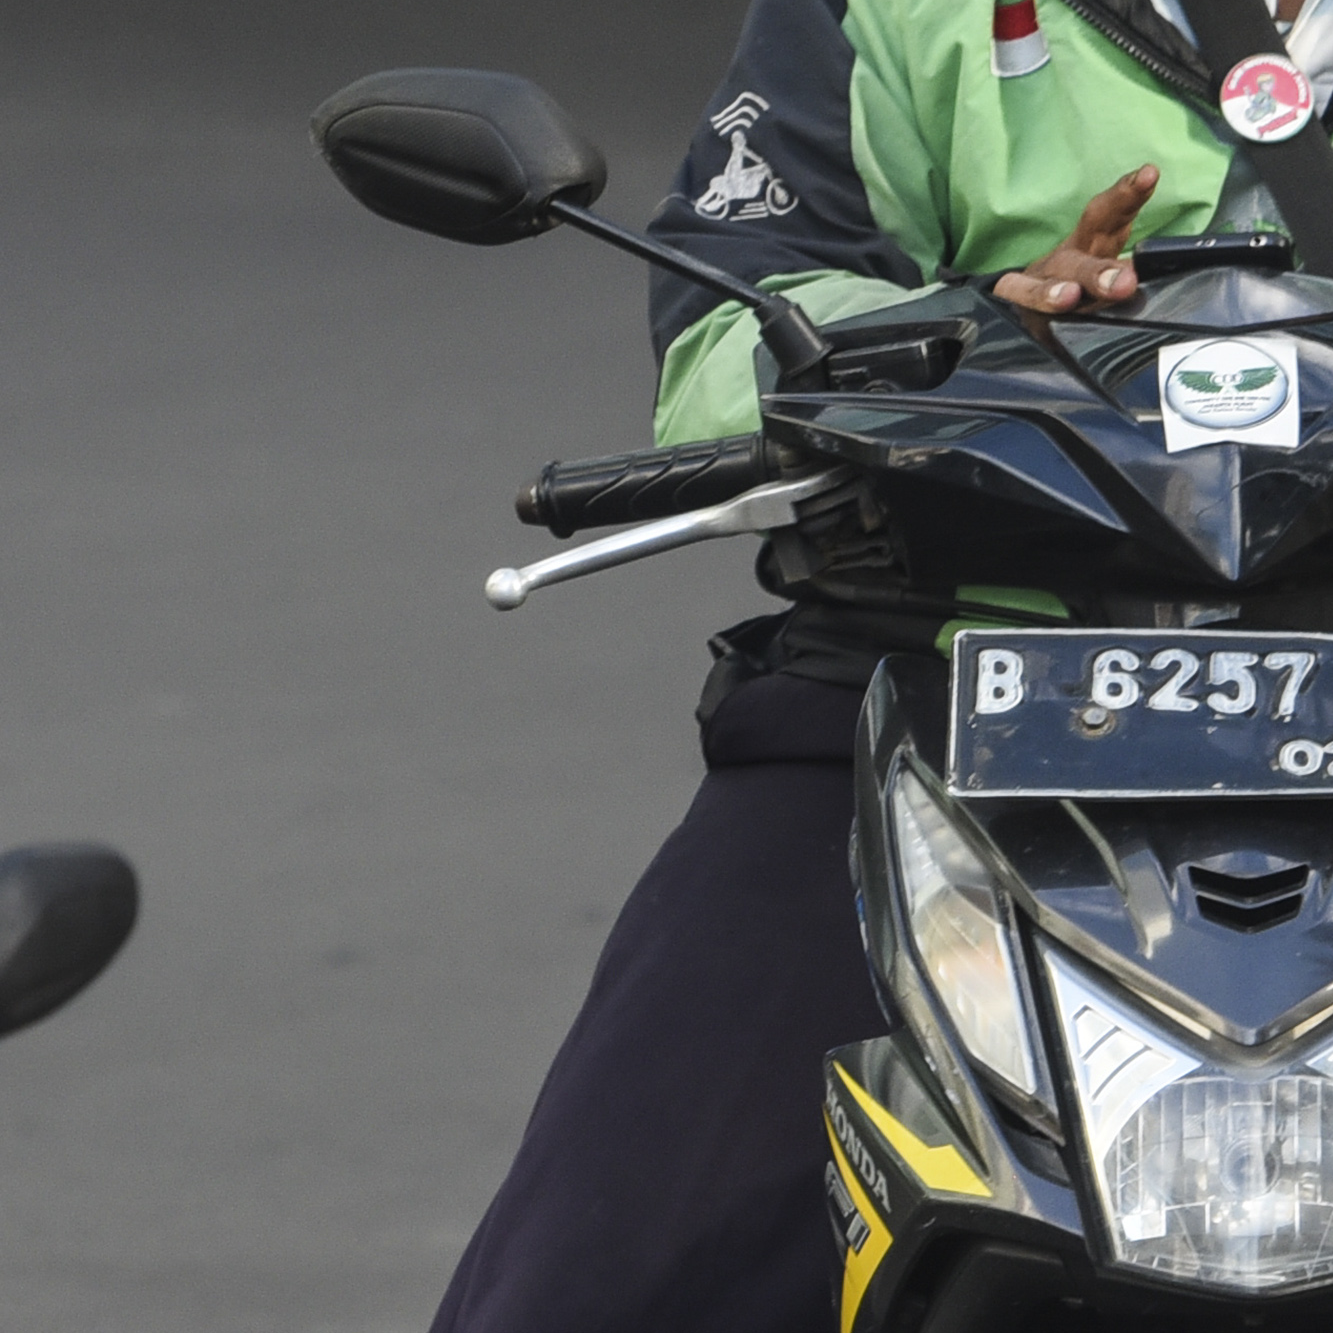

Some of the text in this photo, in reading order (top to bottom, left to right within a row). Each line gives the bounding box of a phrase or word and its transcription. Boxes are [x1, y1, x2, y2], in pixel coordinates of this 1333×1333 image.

[975, 648, 1024, 714] B
[1091, 648, 1317, 718] 6257
[825, 1078, 893, 1215] HONDA
